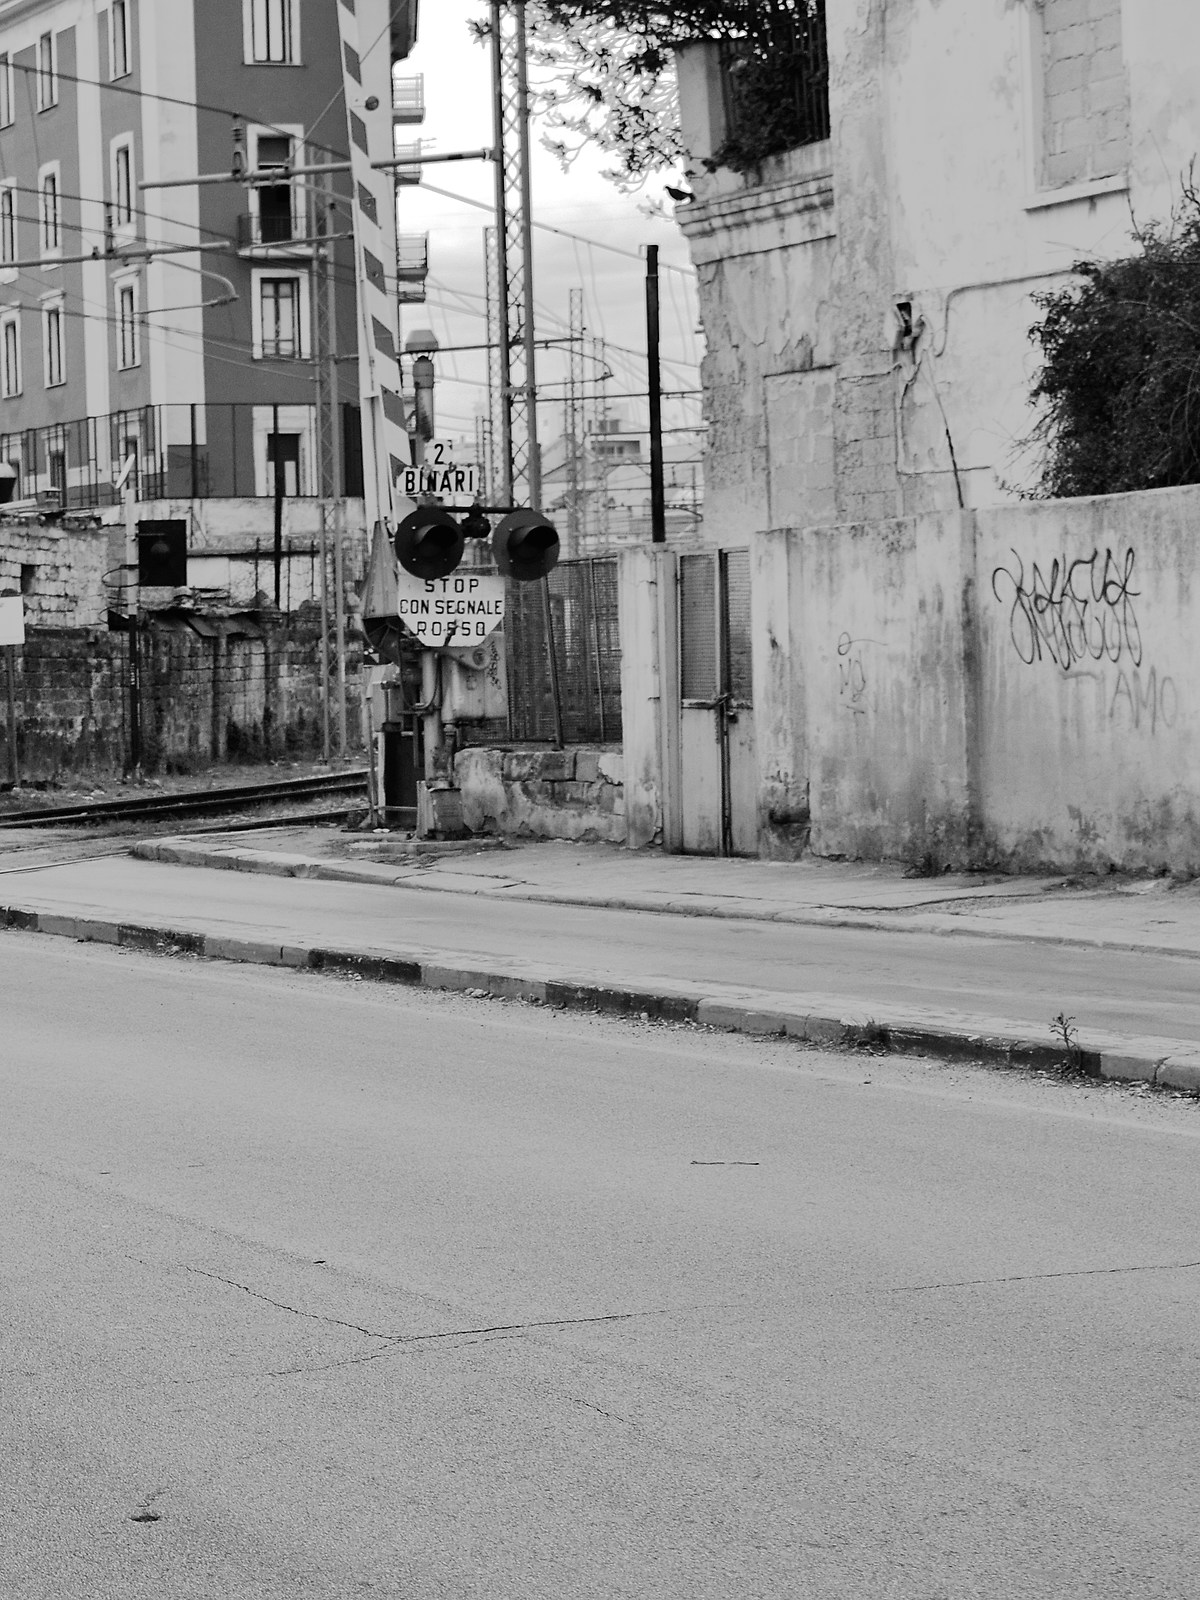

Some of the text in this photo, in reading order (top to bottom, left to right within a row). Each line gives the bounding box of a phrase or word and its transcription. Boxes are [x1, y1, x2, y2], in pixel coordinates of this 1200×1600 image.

[434, 443, 444, 465] 2
[405, 470, 474, 492] BINARI
[424, 578, 479, 593] STOP
[400, 599, 503, 615] CON SEGNALE
[416, 621, 486, 637] ROSSO
